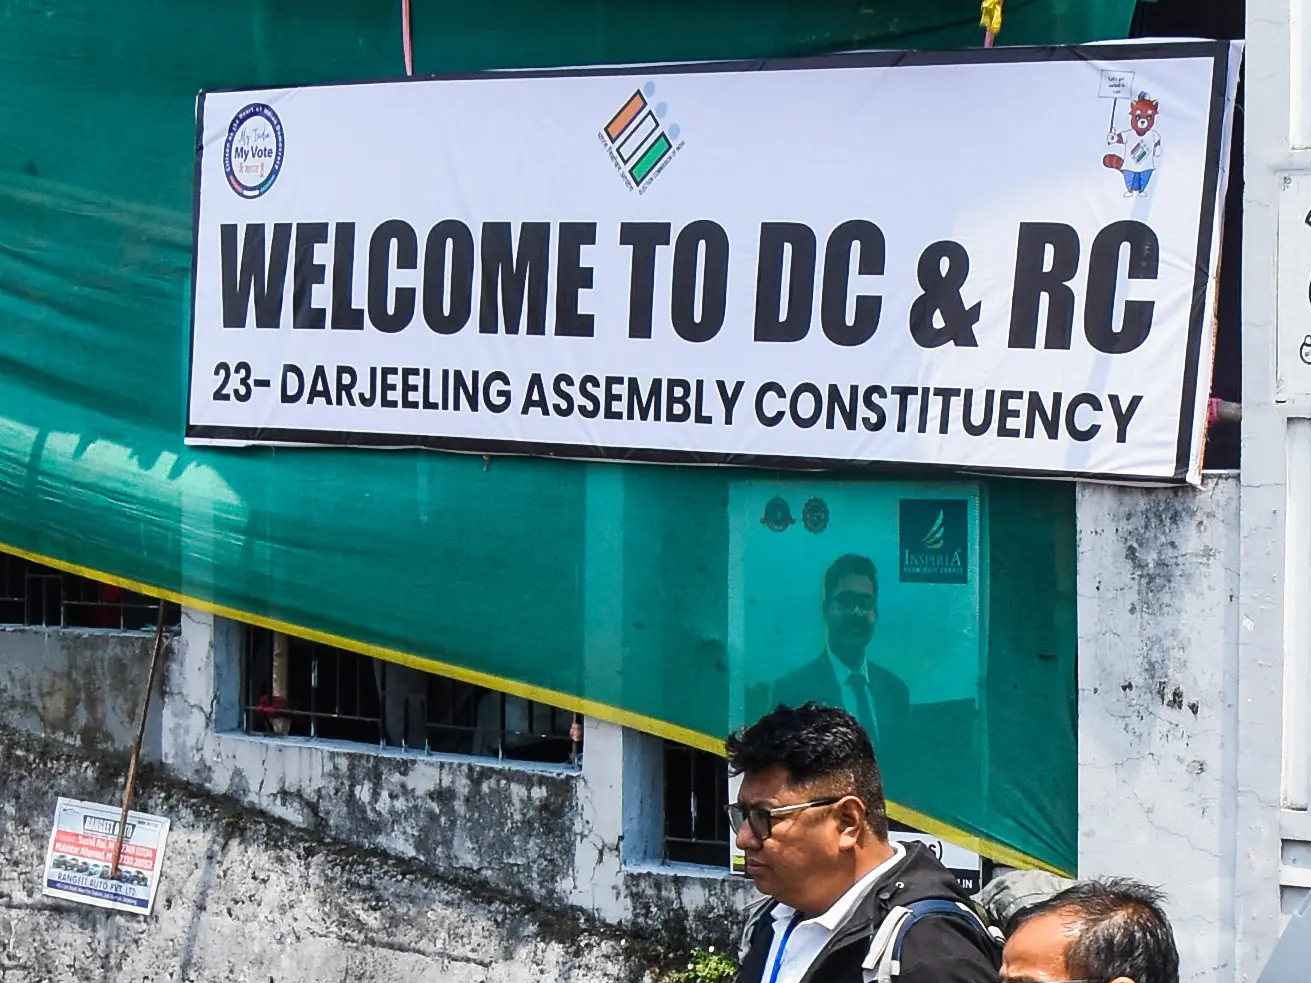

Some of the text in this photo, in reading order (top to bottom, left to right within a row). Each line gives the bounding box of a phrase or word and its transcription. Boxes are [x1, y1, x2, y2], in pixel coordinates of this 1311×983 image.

[234, 145, 273, 162] My Vote
[219, 217, 1159, 354] WELCOME TO DC & RC
[280, 364, 513, 414] DARJEELING
[520, 371, 746, 426] ASSEMBLY
[754, 381, 1145, 444] CONSTITUENCY
[89, 877, 109, 890] AUTO
